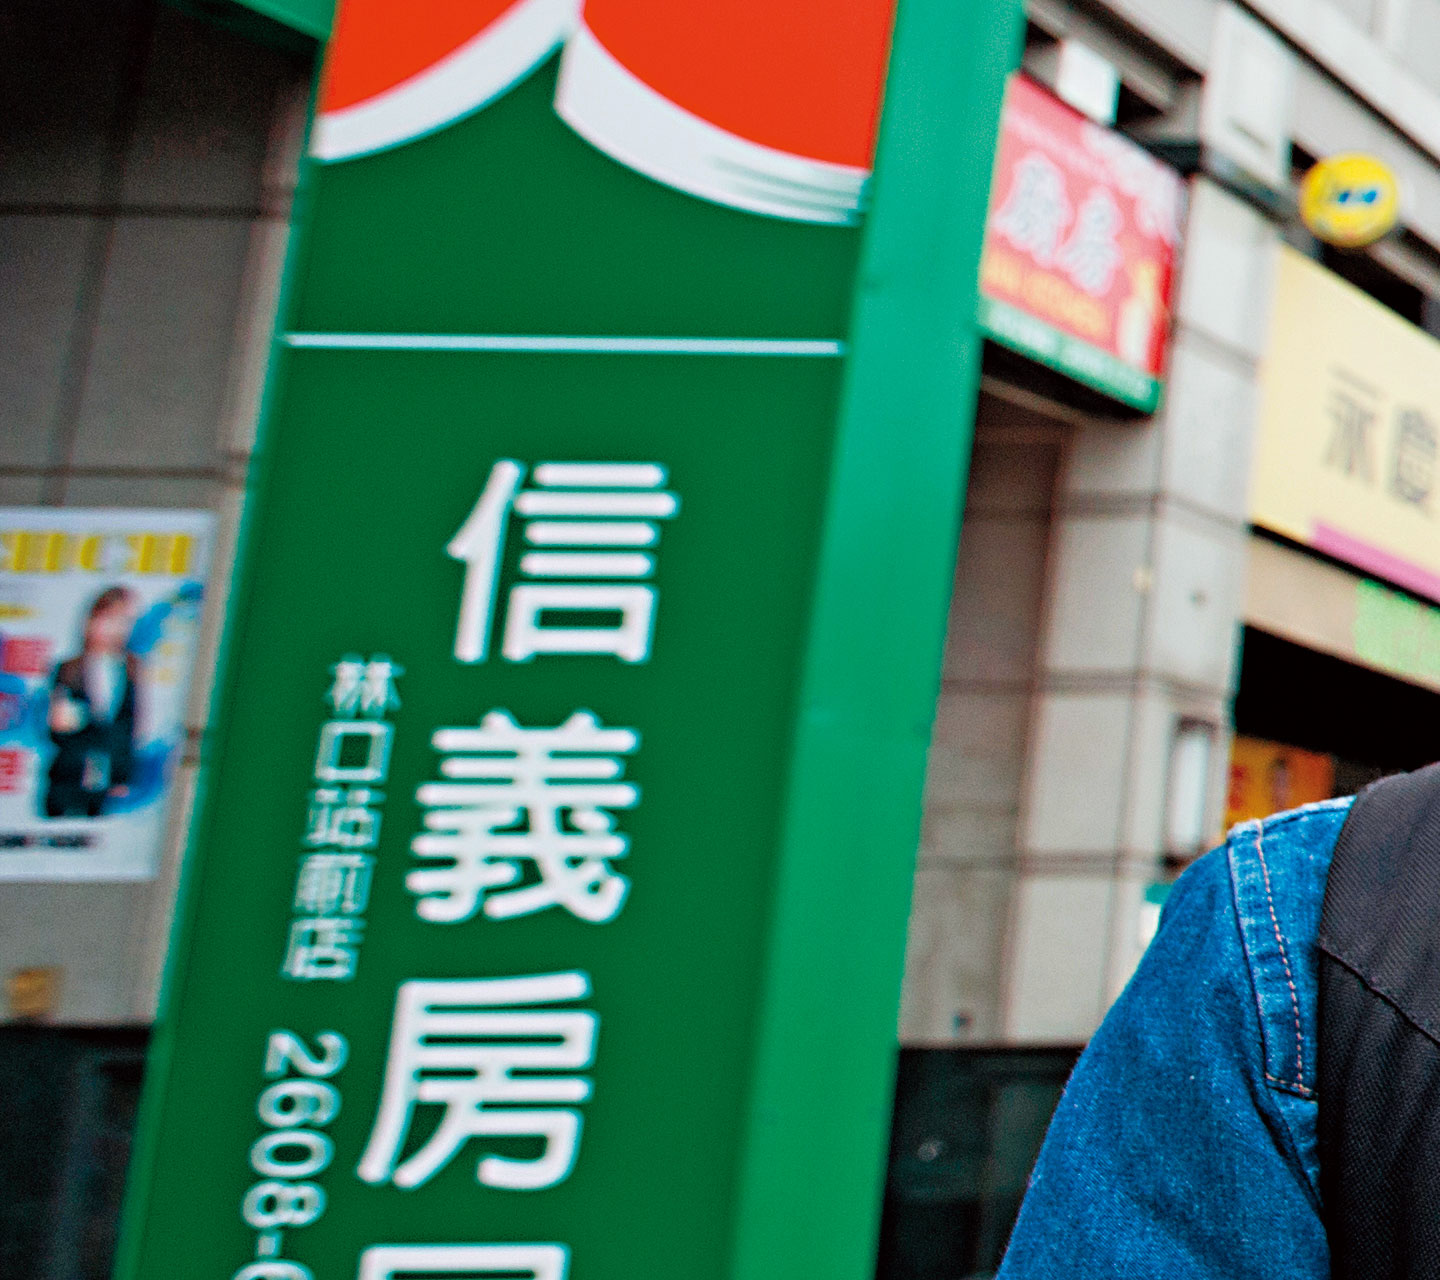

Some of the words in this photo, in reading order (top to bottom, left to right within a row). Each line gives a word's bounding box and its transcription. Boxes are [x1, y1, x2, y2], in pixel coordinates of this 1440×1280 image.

[282, 651, 402, 983] 林口站前店
